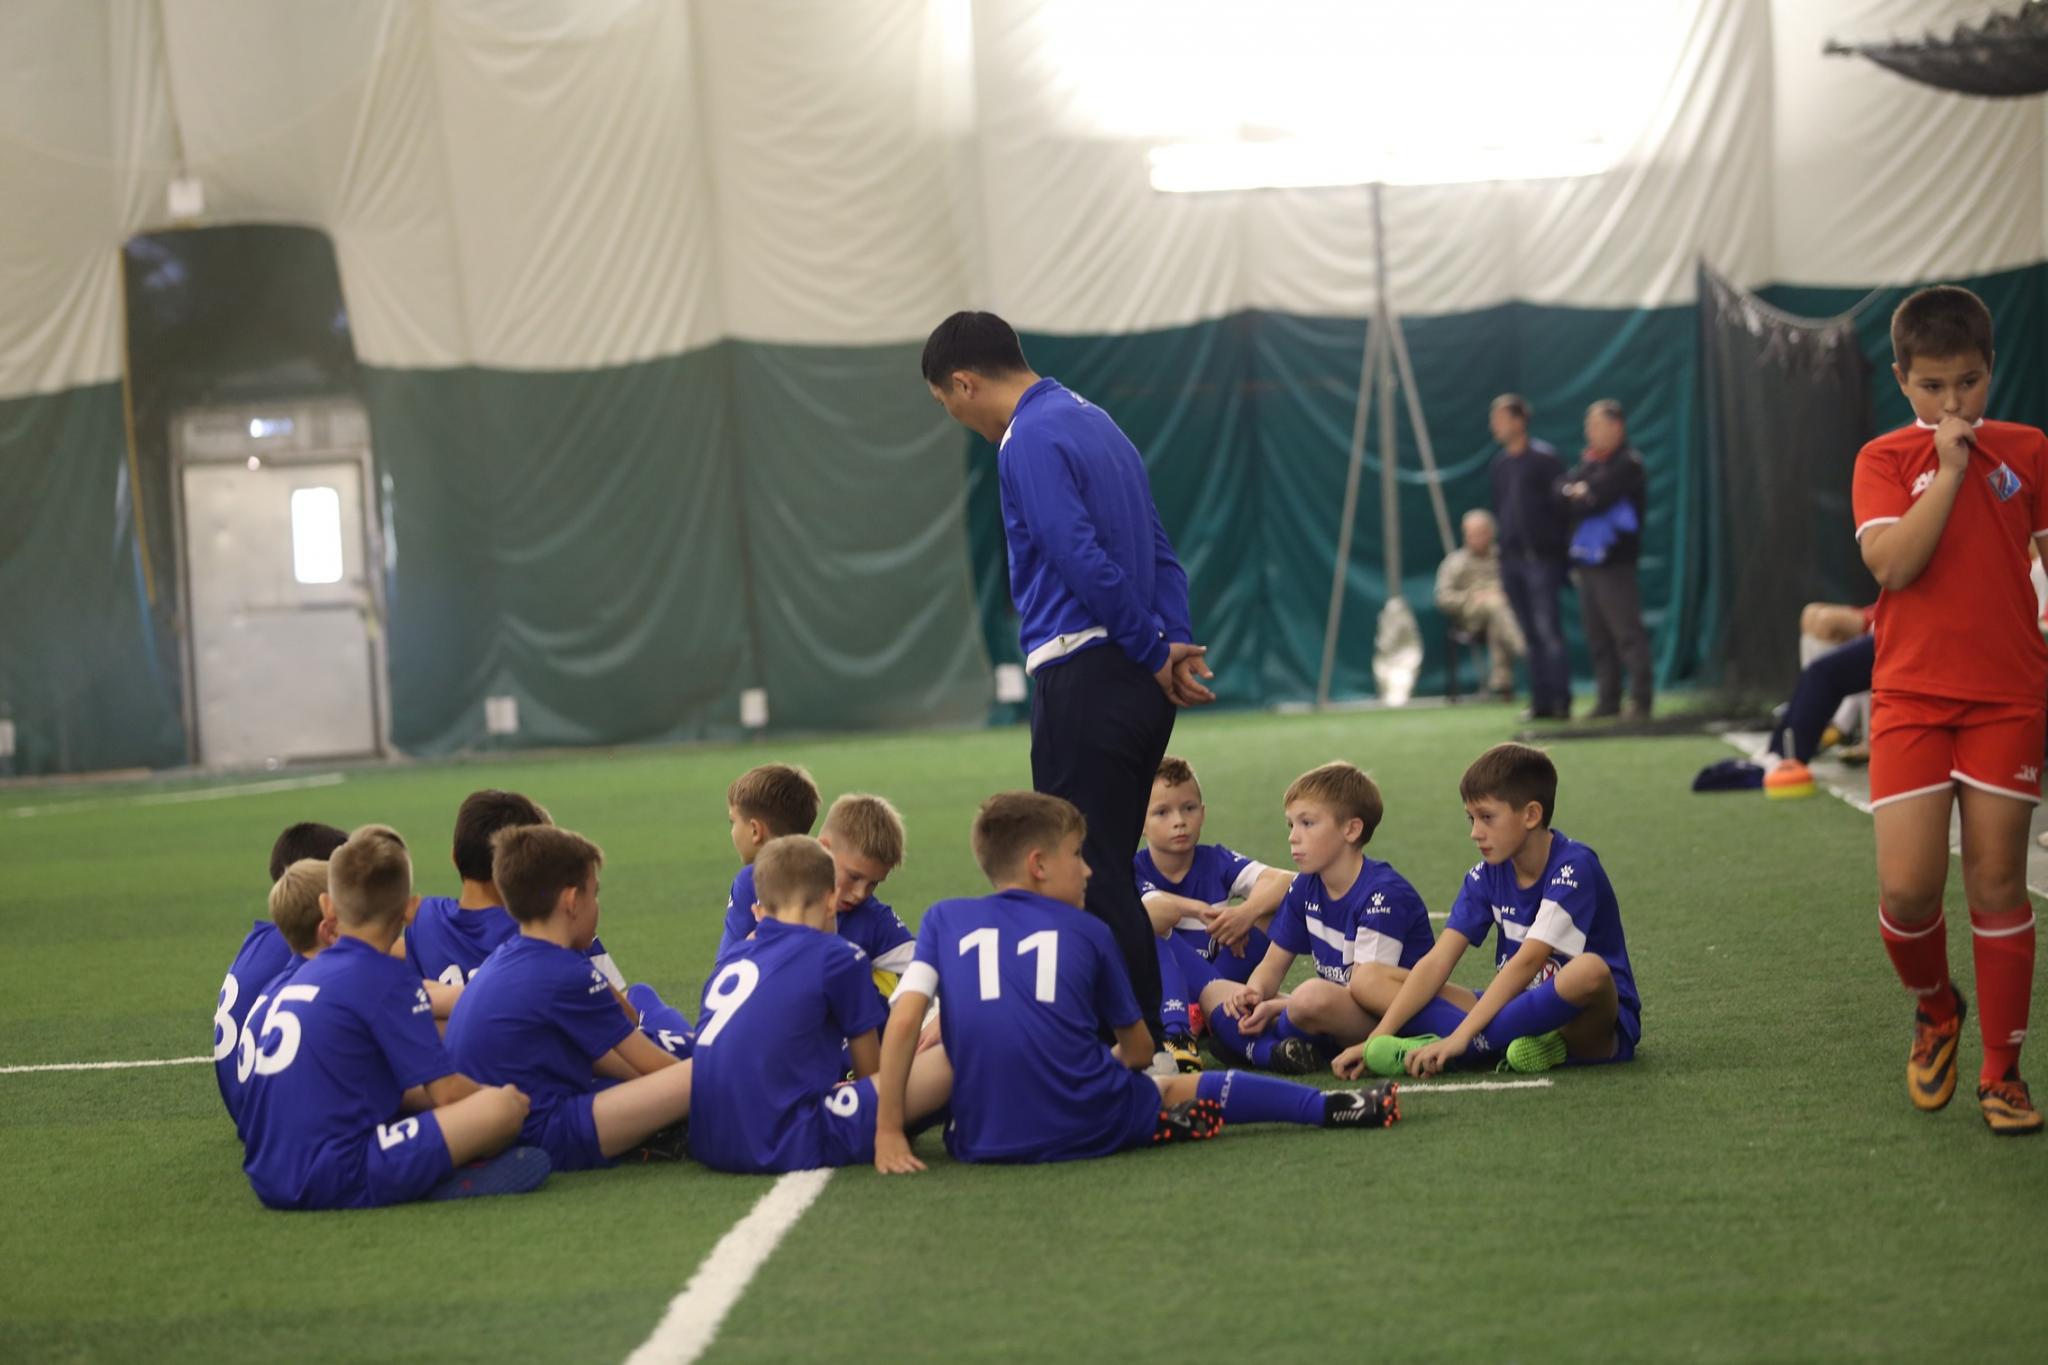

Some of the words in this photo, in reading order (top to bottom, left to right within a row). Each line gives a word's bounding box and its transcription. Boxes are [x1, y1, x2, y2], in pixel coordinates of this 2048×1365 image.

[1552, 877, 1578, 889] KELME
[1366, 906, 1392, 915] KELME
[958, 927, 1059, 1003] 11
[696, 958, 759, 1046] 9
[377, 1117, 419, 1151] 5
